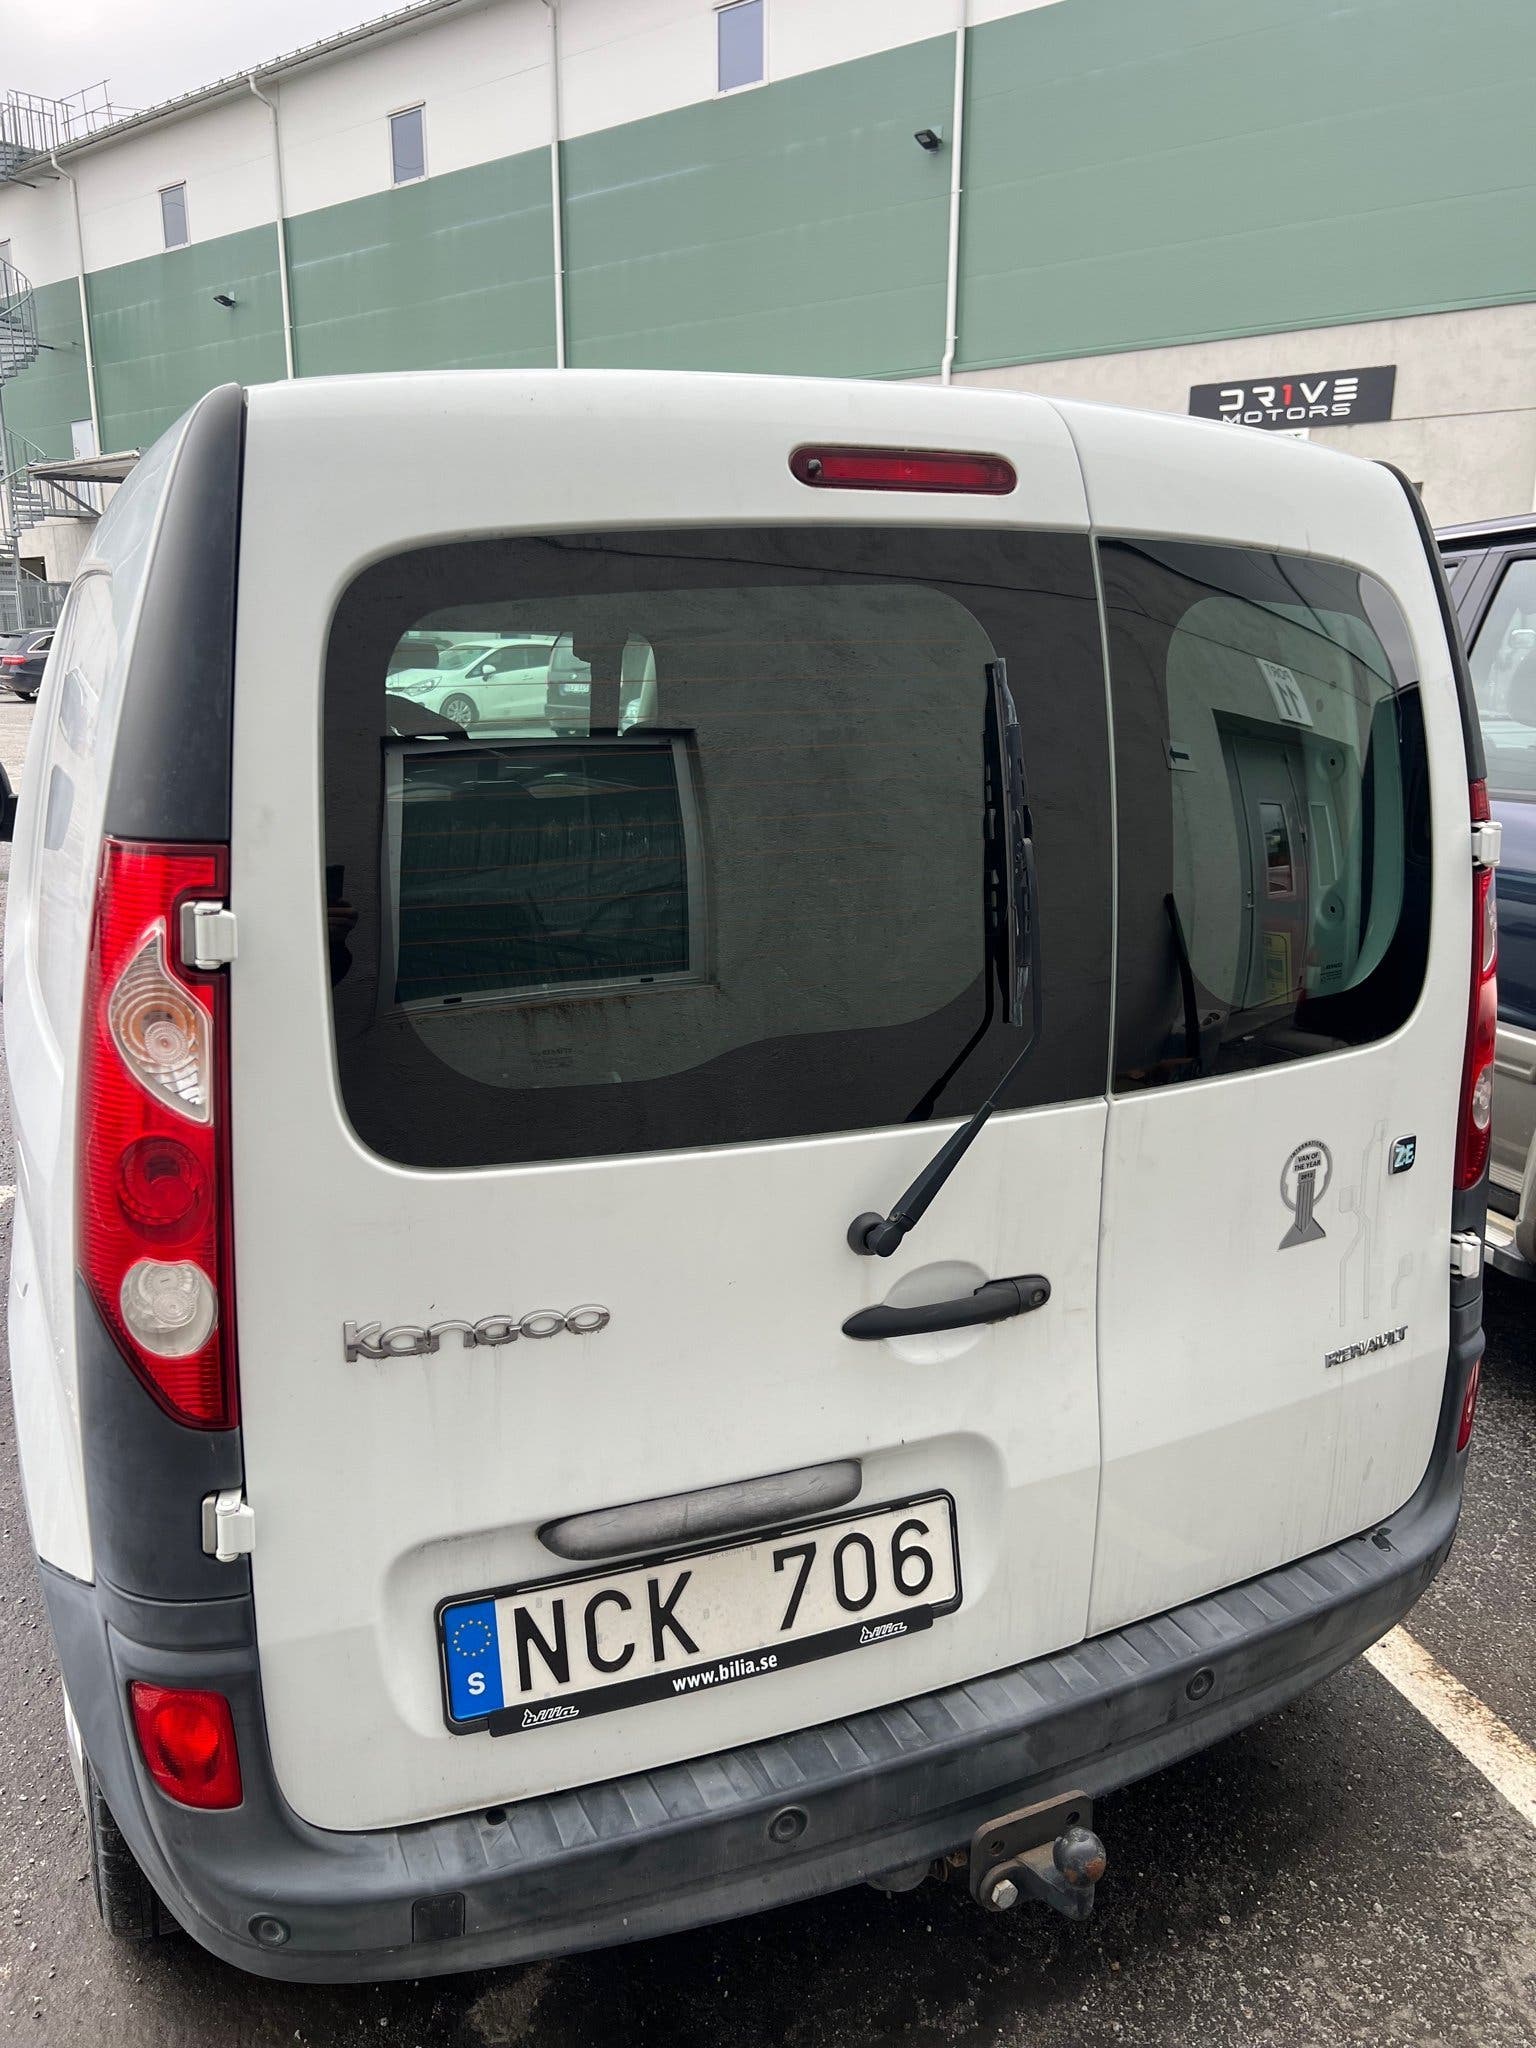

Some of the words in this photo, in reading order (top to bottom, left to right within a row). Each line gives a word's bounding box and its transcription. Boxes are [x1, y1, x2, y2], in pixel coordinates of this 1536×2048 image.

[1222, 402, 1351, 425] MOTORS
[1294, 1163, 1304, 1171] THE
[1306, 1159, 1321, 1169] YEAR
[1297, 1154, 1310, 1162] VAN
[1310, 1151, 1319, 1159] OF
[343, 1303, 611, 1363] Kangoo
[1324, 1325, 1408, 1369] RENAULT
[514, 1570, 700, 1692] NCK
[773, 1518, 934, 1631] 706
[467, 1671, 486, 1696] S
[672, 1652, 778, 1693] www.bilia.se
